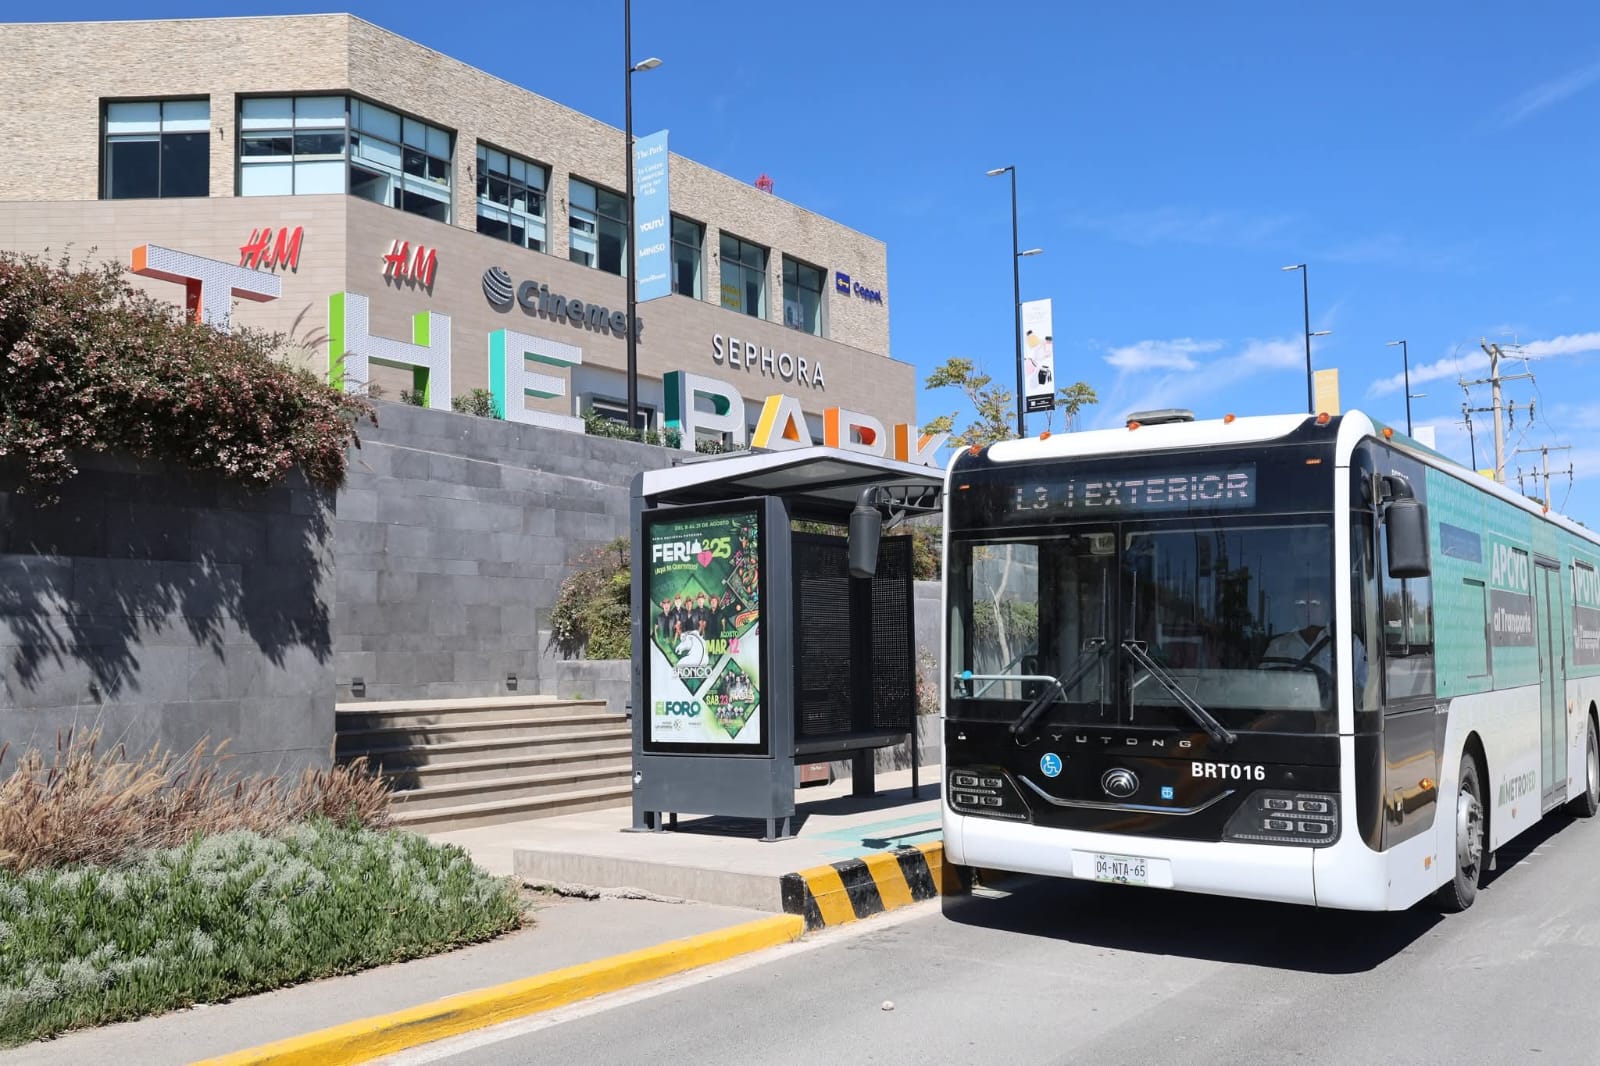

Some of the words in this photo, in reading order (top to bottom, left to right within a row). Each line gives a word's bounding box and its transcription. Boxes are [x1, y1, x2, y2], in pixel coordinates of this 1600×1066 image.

[239, 226, 304, 272] H&M
[382, 239, 437, 286] H&M
[517, 279, 645, 341] Cineme
[131, 242, 585, 434] THE
[712, 333, 825, 387] SEPHORA
[1085, 472, 1249, 507] EXTERIOR
[652, 538, 702, 563] FERIA
[705, 639, 727, 655] MAR
[1051, 733, 1192, 749] YUTONG
[1191, 761, 1267, 781] BRT016
[1096, 860, 1146, 878] 04-NTA-65
